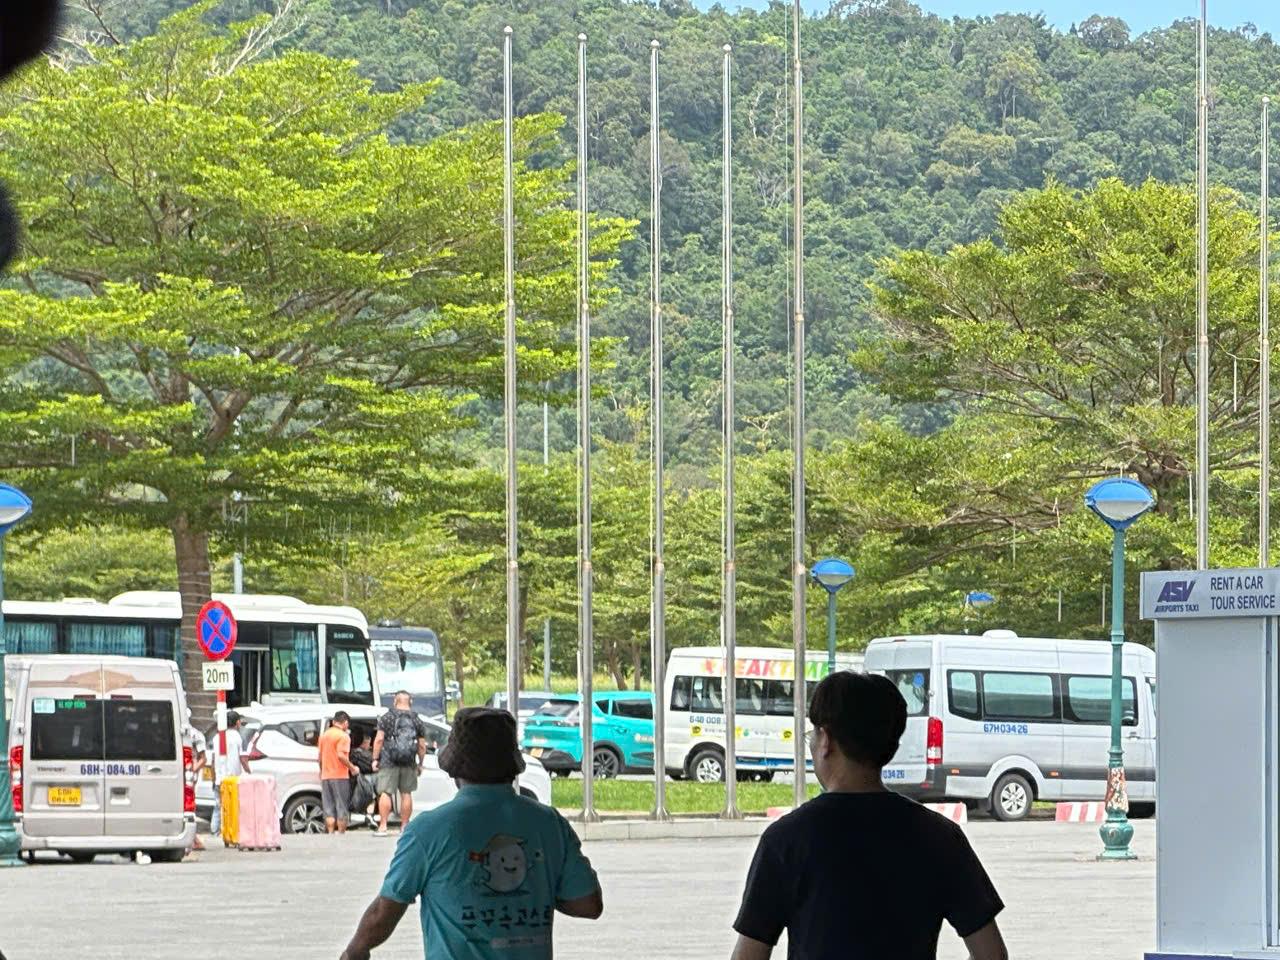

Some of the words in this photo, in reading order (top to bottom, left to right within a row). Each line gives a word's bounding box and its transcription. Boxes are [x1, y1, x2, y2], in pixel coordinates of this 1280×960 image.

[1211, 577, 1235, 591] RENT
[1236, 578, 1243, 590] A
[1245, 576, 1264, 590] CAR
[1185, 603, 1199, 613] TAXI
[1211, 596, 1236, 610] TOUR
[1237, 594, 1275, 610] SERVICE
[206, 668, 229, 684] 20m
